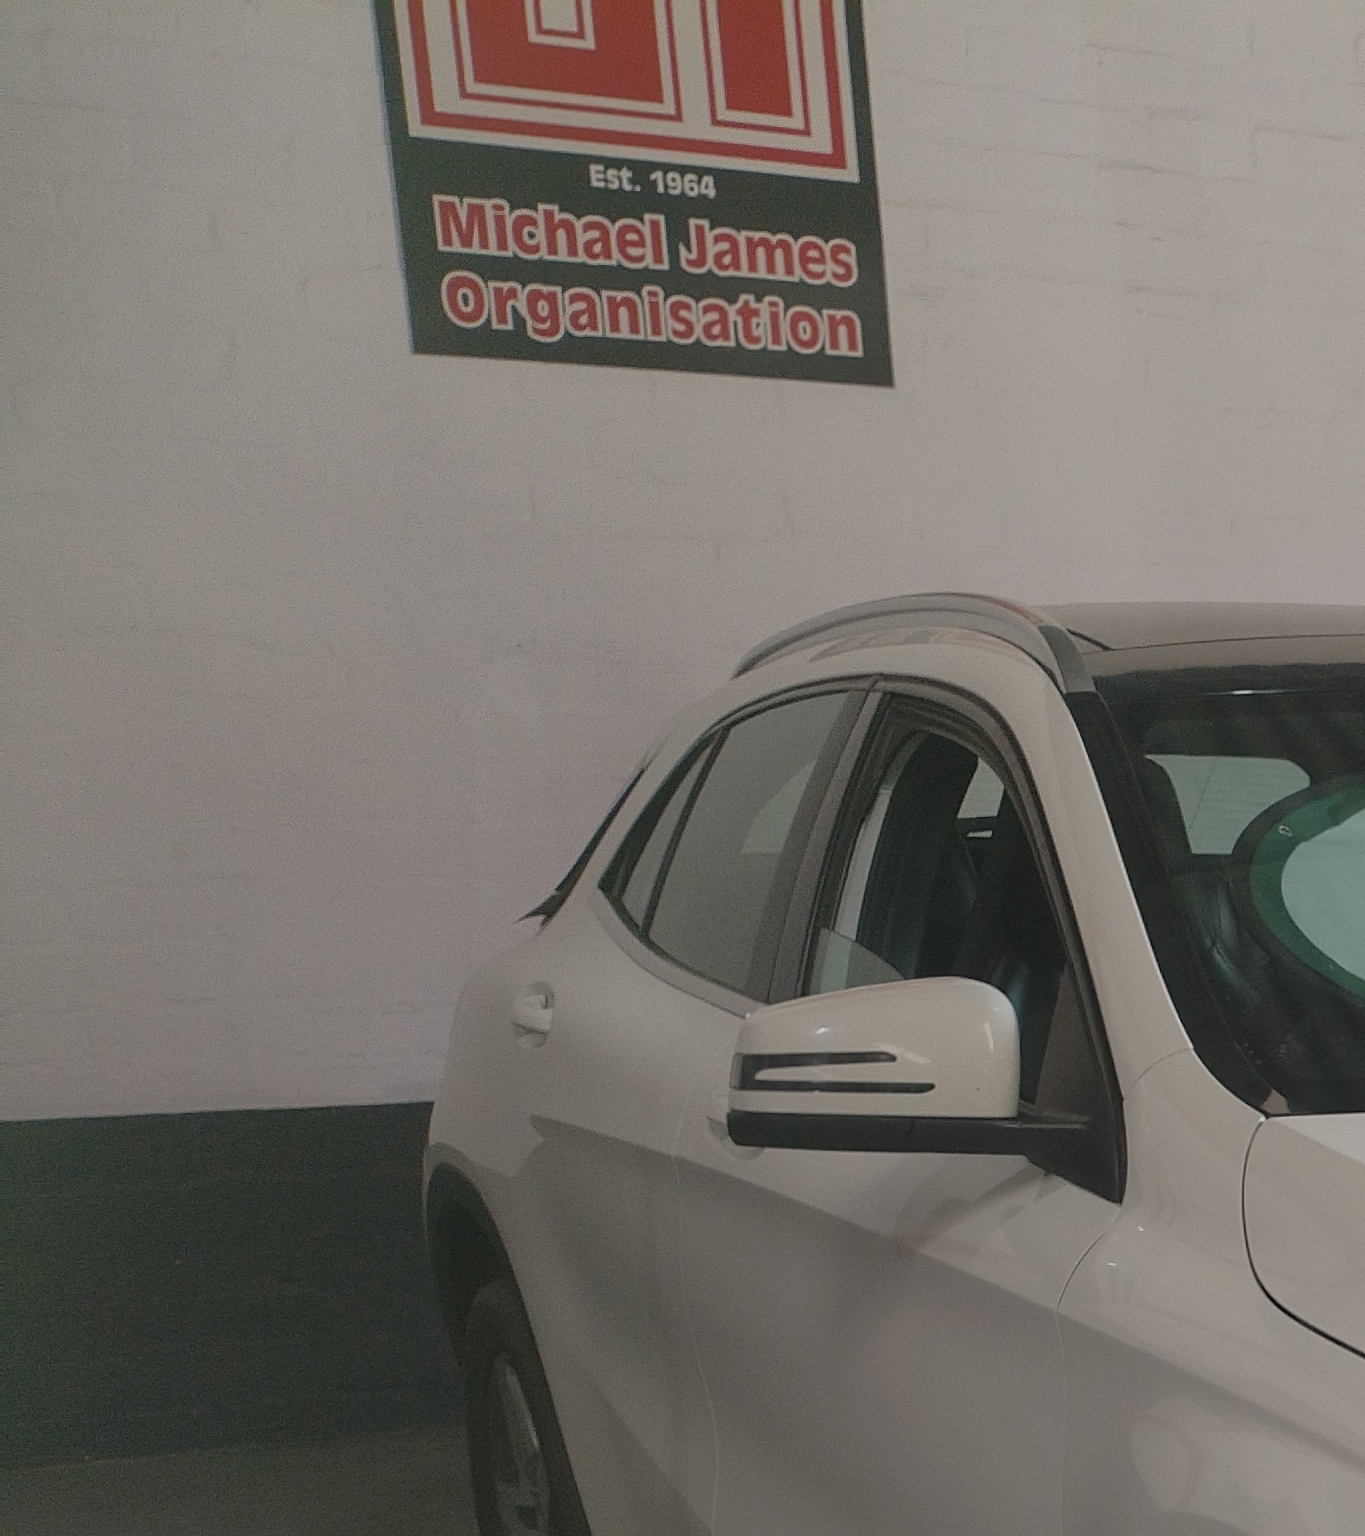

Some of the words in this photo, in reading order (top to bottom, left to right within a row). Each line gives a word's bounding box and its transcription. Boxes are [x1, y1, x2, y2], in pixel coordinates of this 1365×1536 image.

[588, 162, 642, 192] Est.
[649, 169, 717, 200] 1964
[432, 194, 670, 271] Michael
[679, 217, 859, 288] James
[440, 269, 865, 358] Organisation
